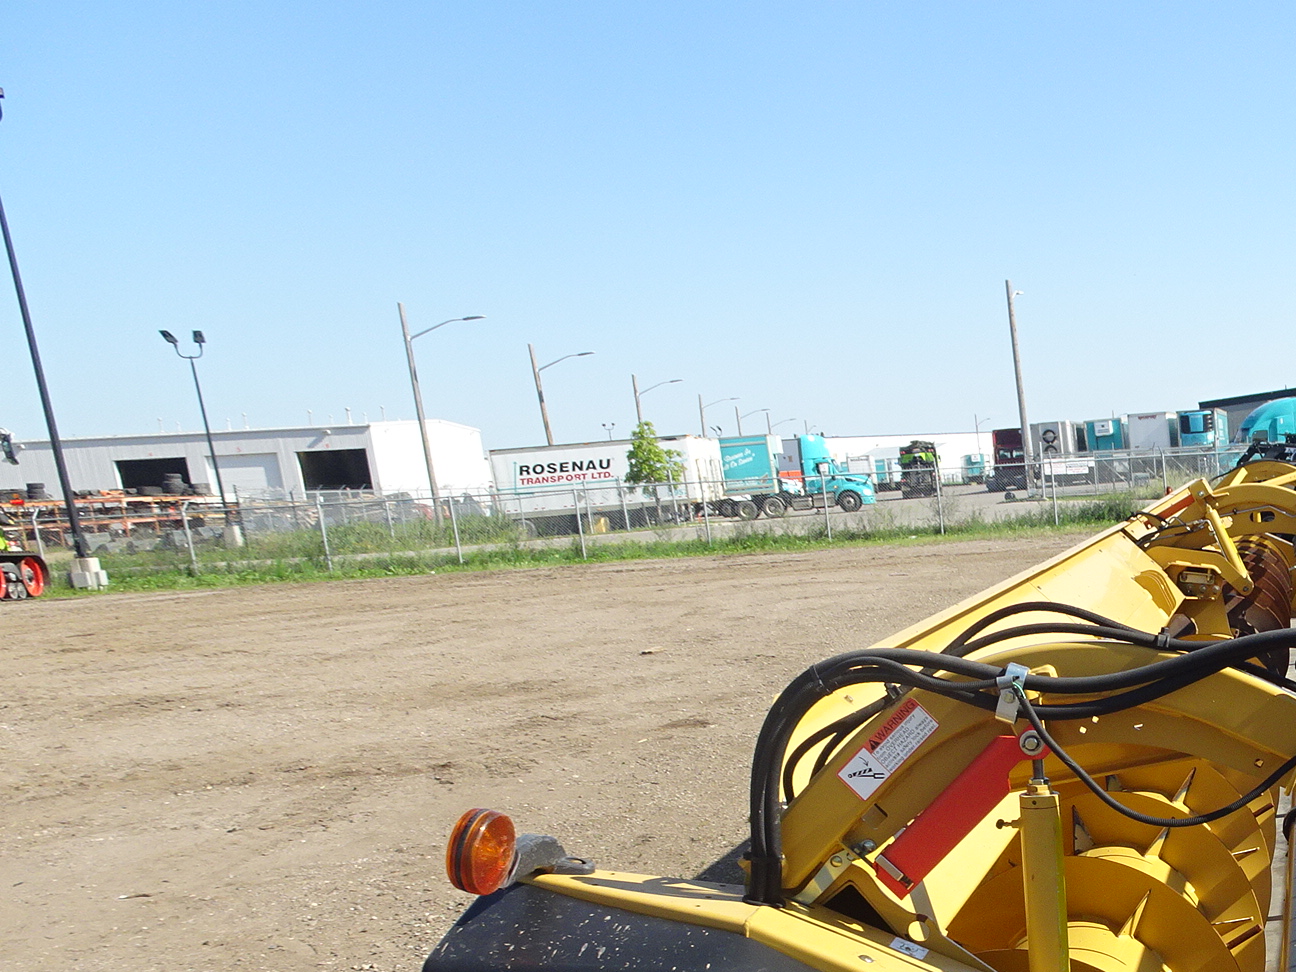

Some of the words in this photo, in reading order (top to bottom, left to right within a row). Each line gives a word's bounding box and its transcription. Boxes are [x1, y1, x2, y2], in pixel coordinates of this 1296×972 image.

[519, 458, 611, 476] ROSENAU
[519, 473, 588, 485] TRANSPORT
[591, 471, 614, 479] LTD.
[875, 700, 916, 741] WARNING
